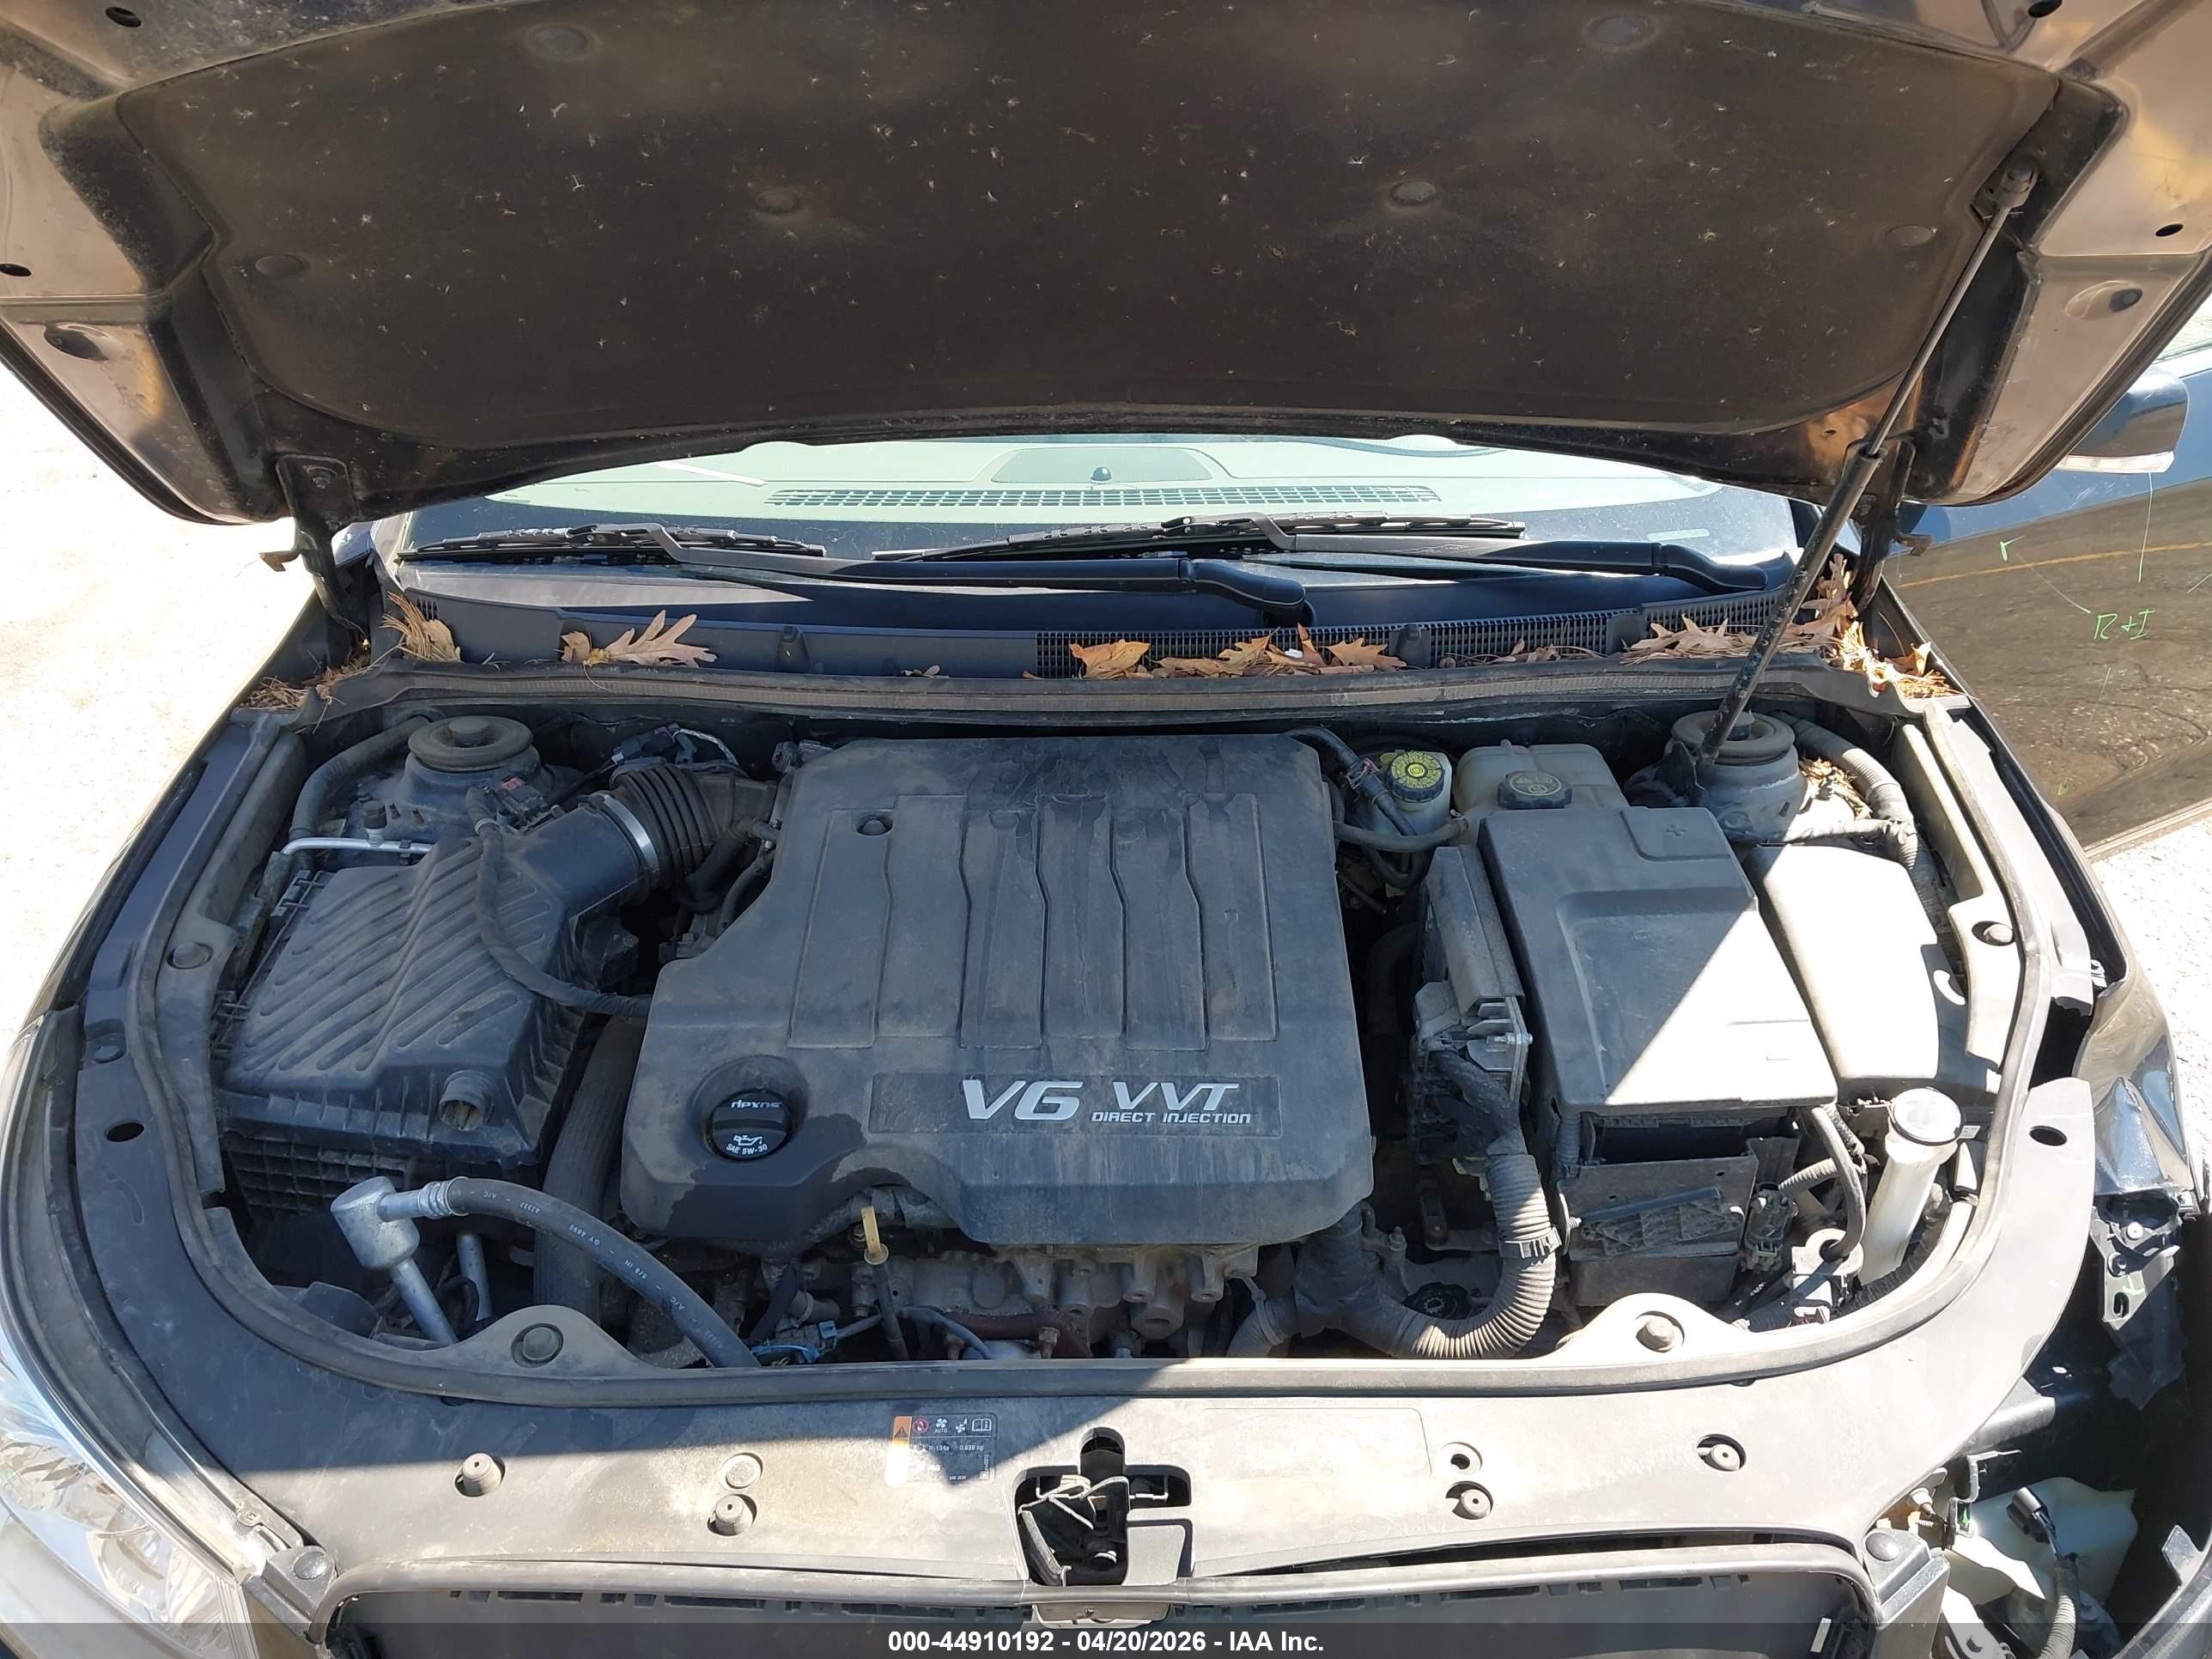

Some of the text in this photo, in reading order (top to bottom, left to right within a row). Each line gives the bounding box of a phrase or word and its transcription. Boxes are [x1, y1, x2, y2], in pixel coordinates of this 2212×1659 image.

[962, 1079, 1240, 1121] V6 VVT
[1091, 1111, 1251, 1125] DIRECT INJECTION
[726, 1144, 769, 1154] SAE 5W-30
